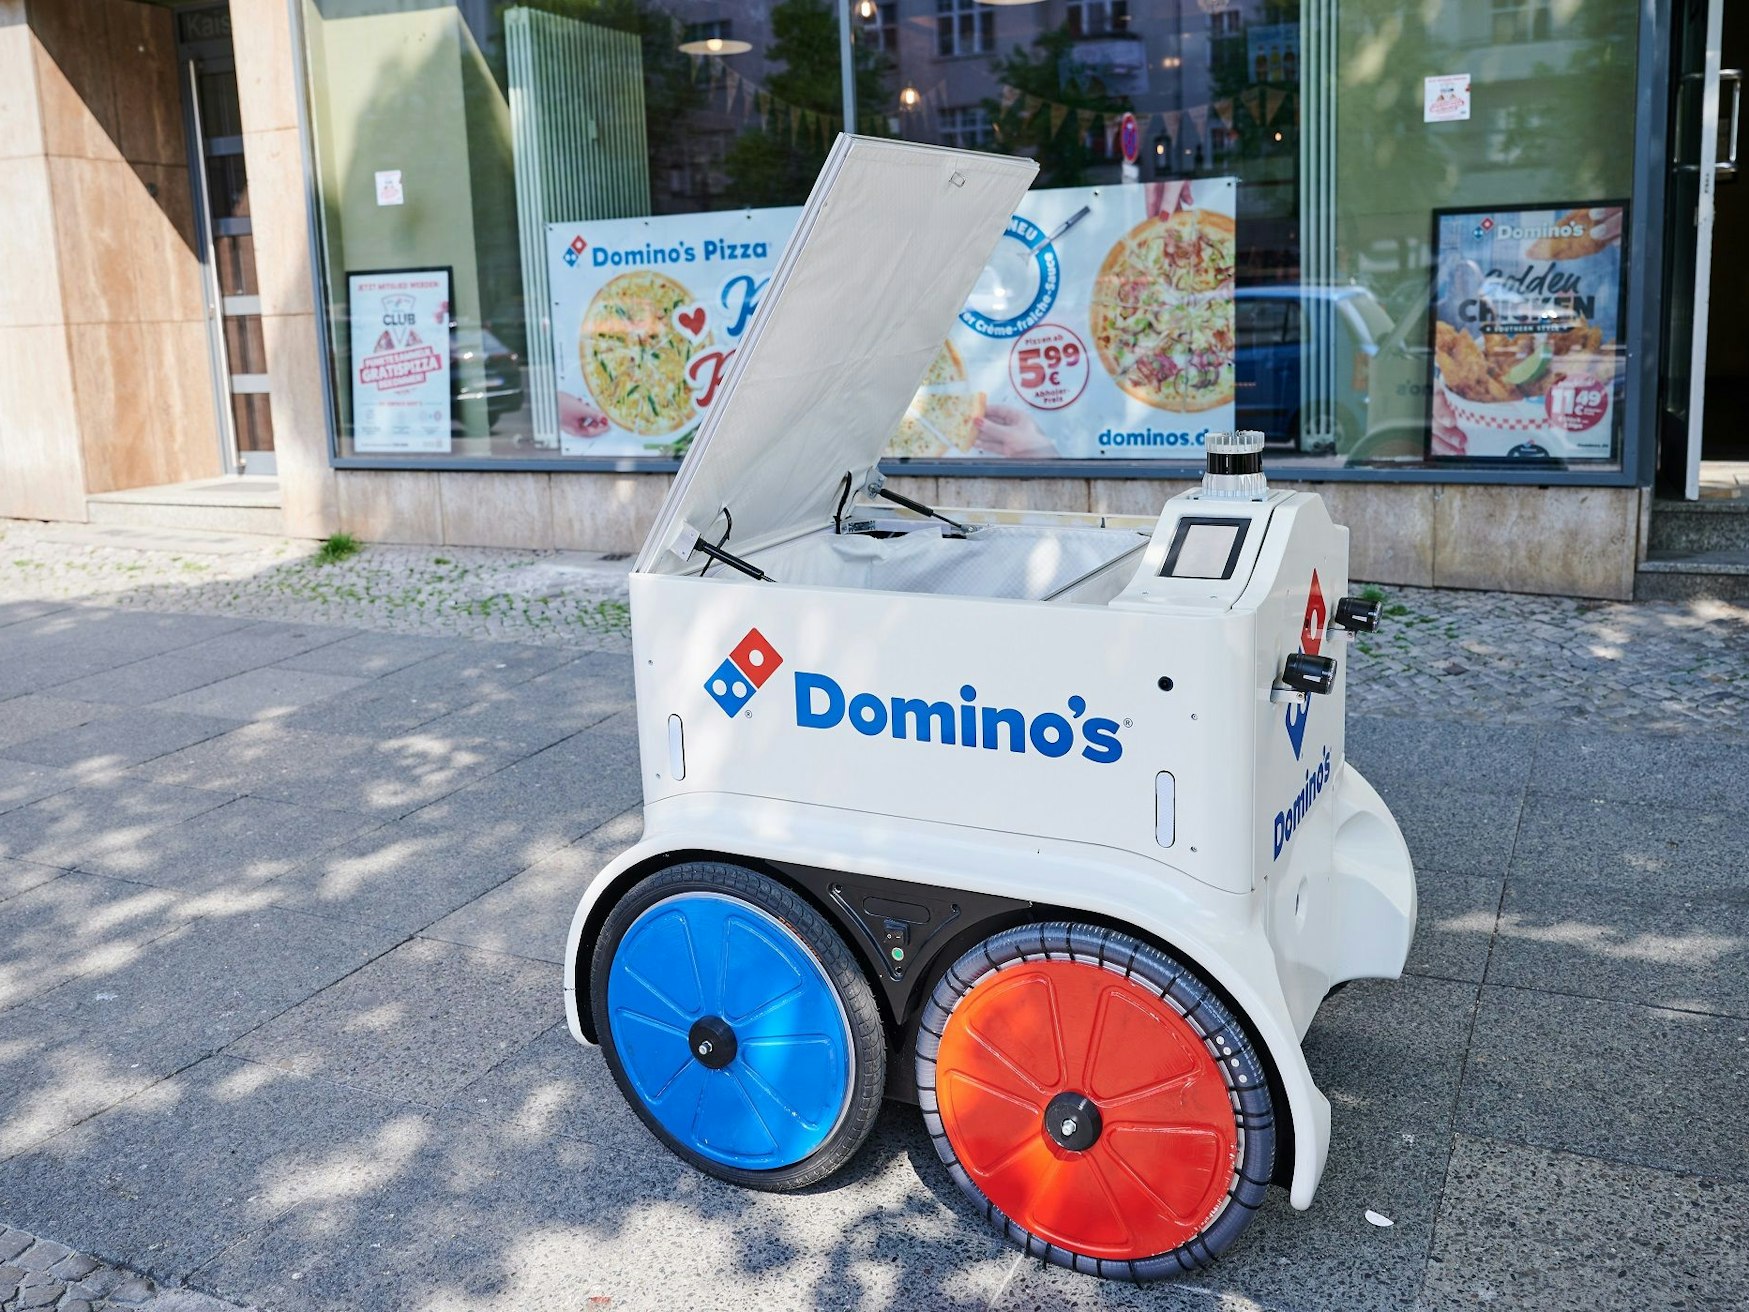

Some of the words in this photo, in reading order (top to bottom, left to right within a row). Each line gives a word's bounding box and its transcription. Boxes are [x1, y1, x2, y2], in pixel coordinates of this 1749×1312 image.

[1497, 221, 1584, 240] Domino's
[592, 240, 696, 267] Domino's
[703, 238, 768, 261] Pizza
[383, 313, 416, 326] CLUB
[1494, 325, 1533, 333] SOUTHERN
[1025, 336, 1051, 345] Pizzen
[361, 355, 439, 382] GRATISPIZZA
[1098, 428, 1209, 446] dominos.d
[794, 671, 1123, 764] Domino's
[1273, 745, 1331, 862] Domino's
